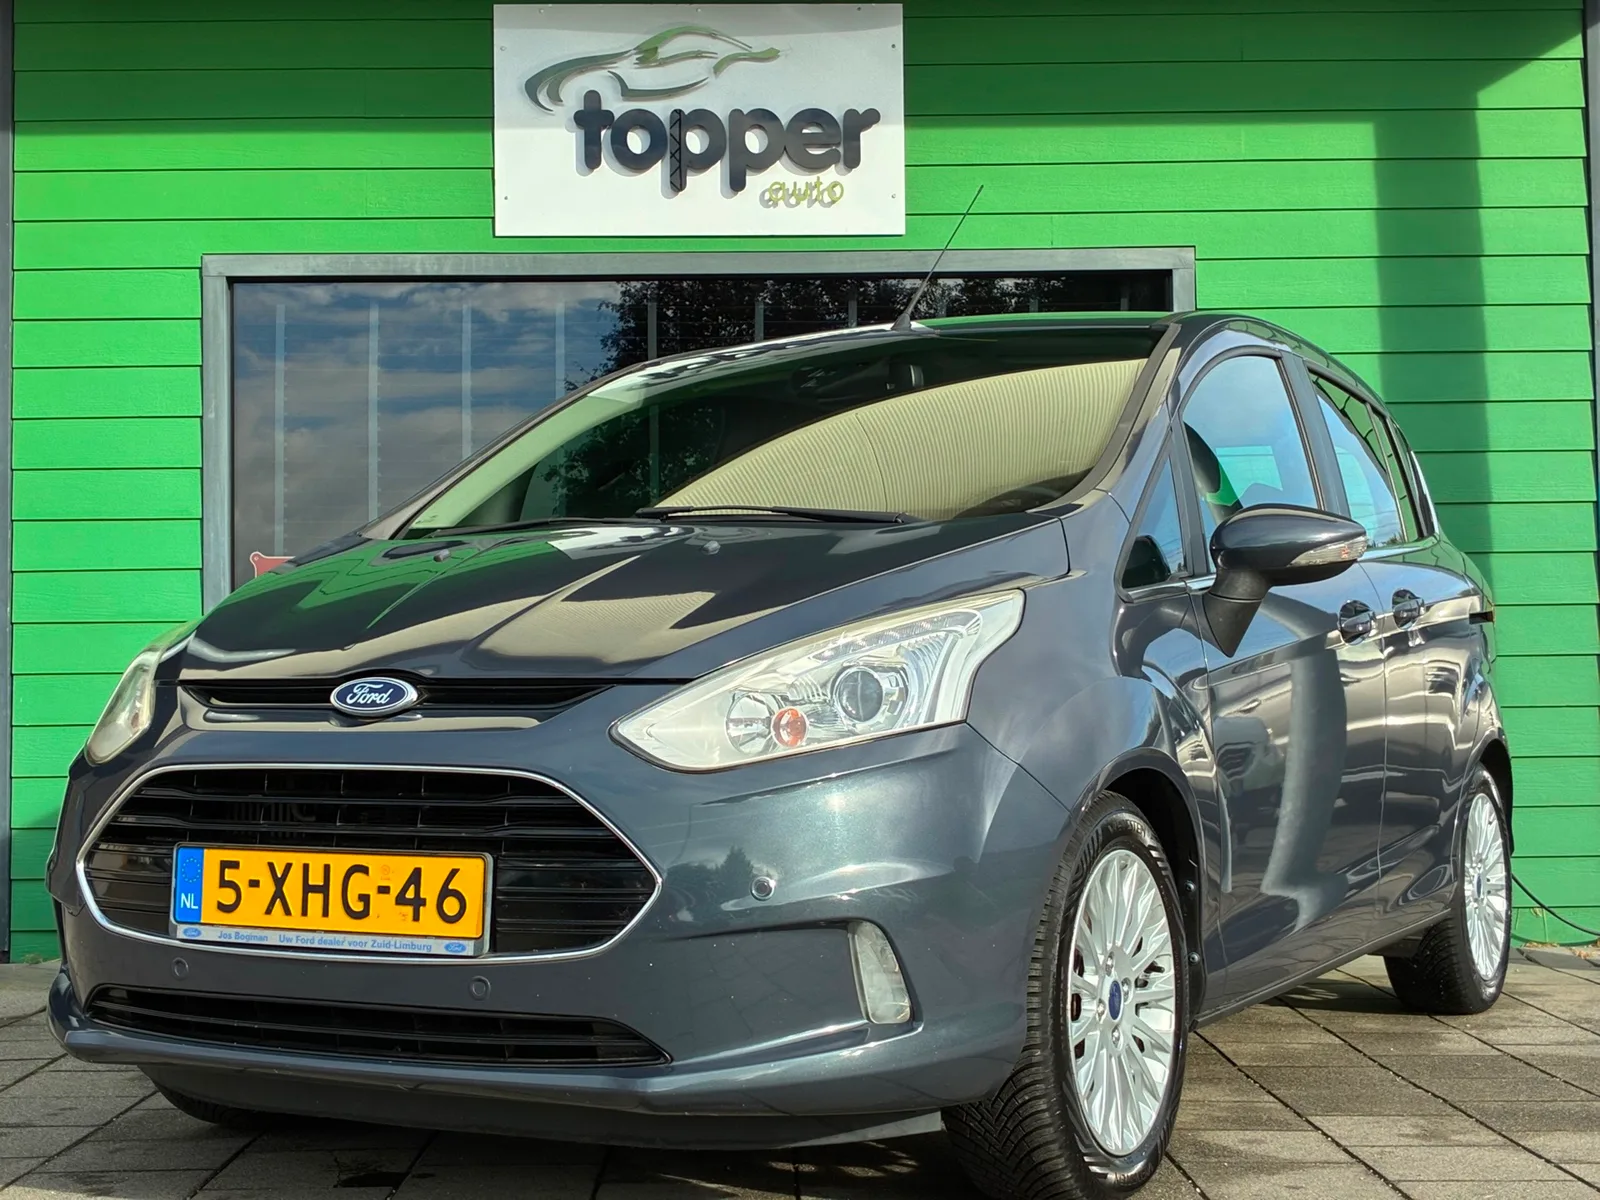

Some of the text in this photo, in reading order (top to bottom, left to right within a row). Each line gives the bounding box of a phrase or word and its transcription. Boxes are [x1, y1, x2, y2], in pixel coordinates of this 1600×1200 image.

[573, 90, 881, 192] topper
[767, 176, 844, 202] auto
[346, 683, 394, 705] Ford
[180, 893, 199, 909] NL
[217, 860, 467, 924] 5-XHG-46
[218, 930, 233, 940] Jos
[279, 934, 432, 952] Uw Ford dealer voor Zuid-Limburg
